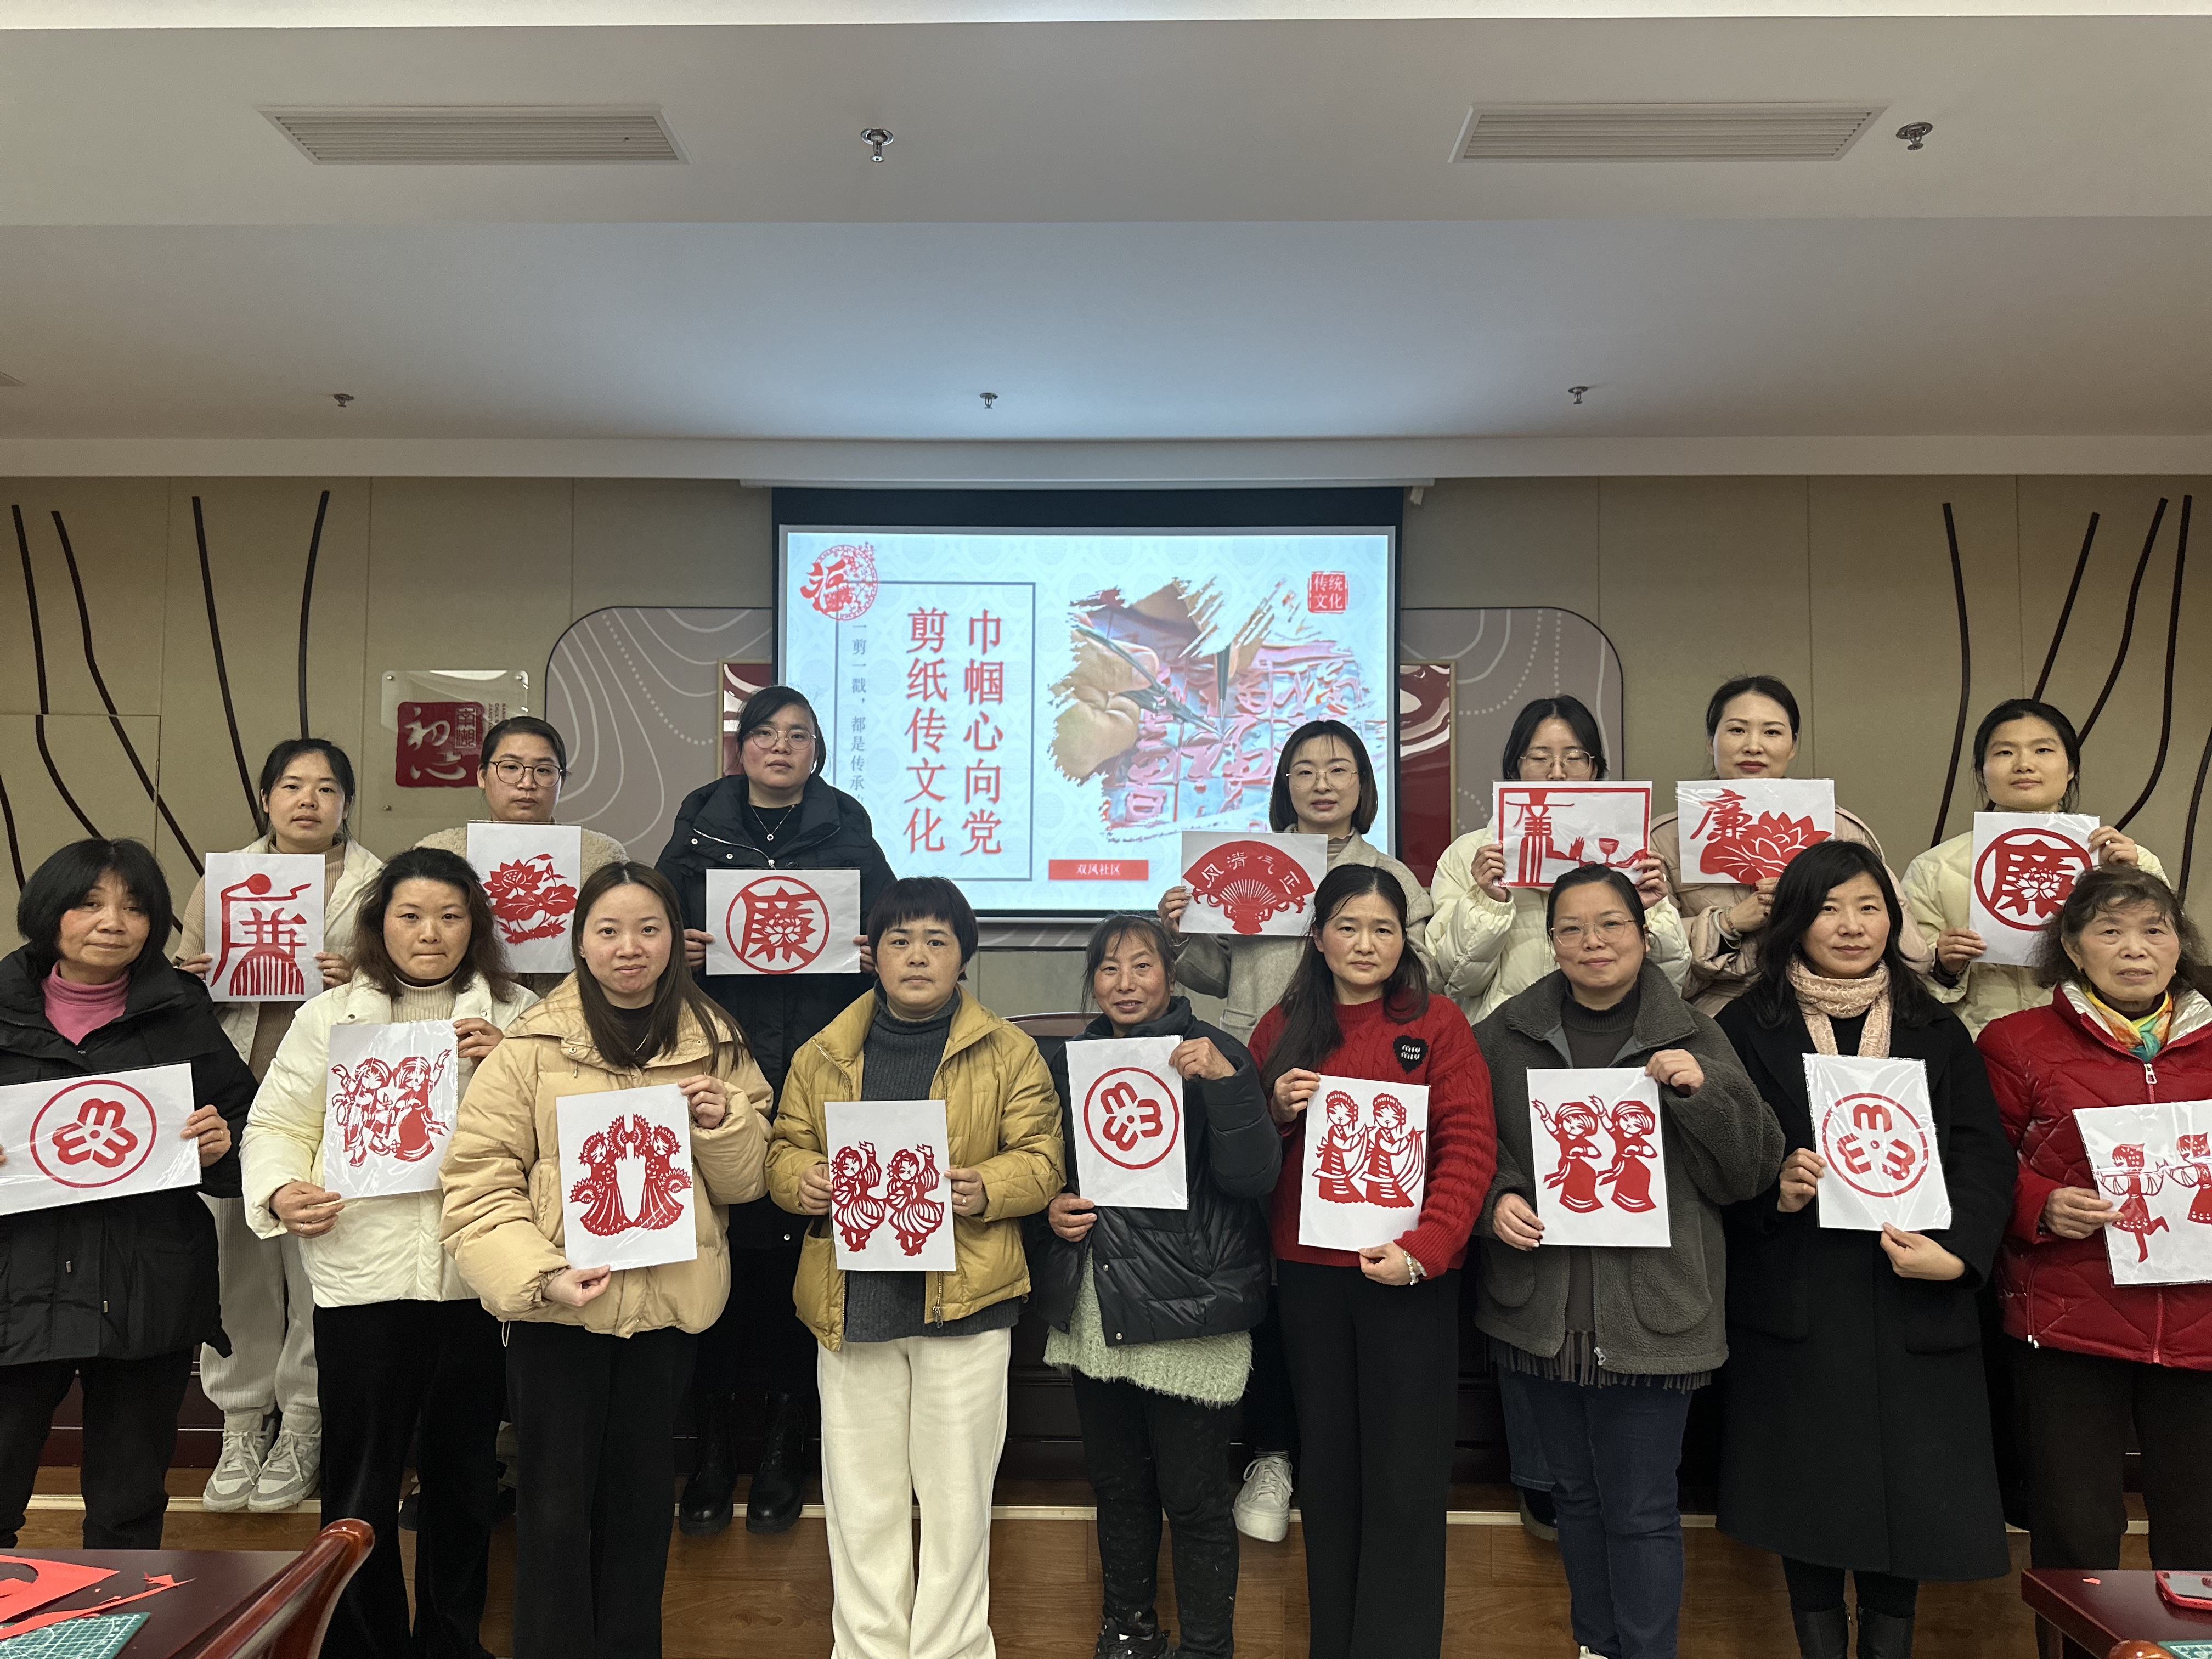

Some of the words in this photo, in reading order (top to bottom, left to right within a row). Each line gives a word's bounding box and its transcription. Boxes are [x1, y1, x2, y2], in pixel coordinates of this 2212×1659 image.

[1314, 575, 1344, 591] 传统
[1314, 593, 1344, 608] 文化
[850, 624, 867, 804] 一剪一戳，都是传承
[904, 606, 949, 854] 剪纸传文化
[960, 608, 1003, 856] 巾帼心向党
[1201, 851, 1300, 894] 风清气正
